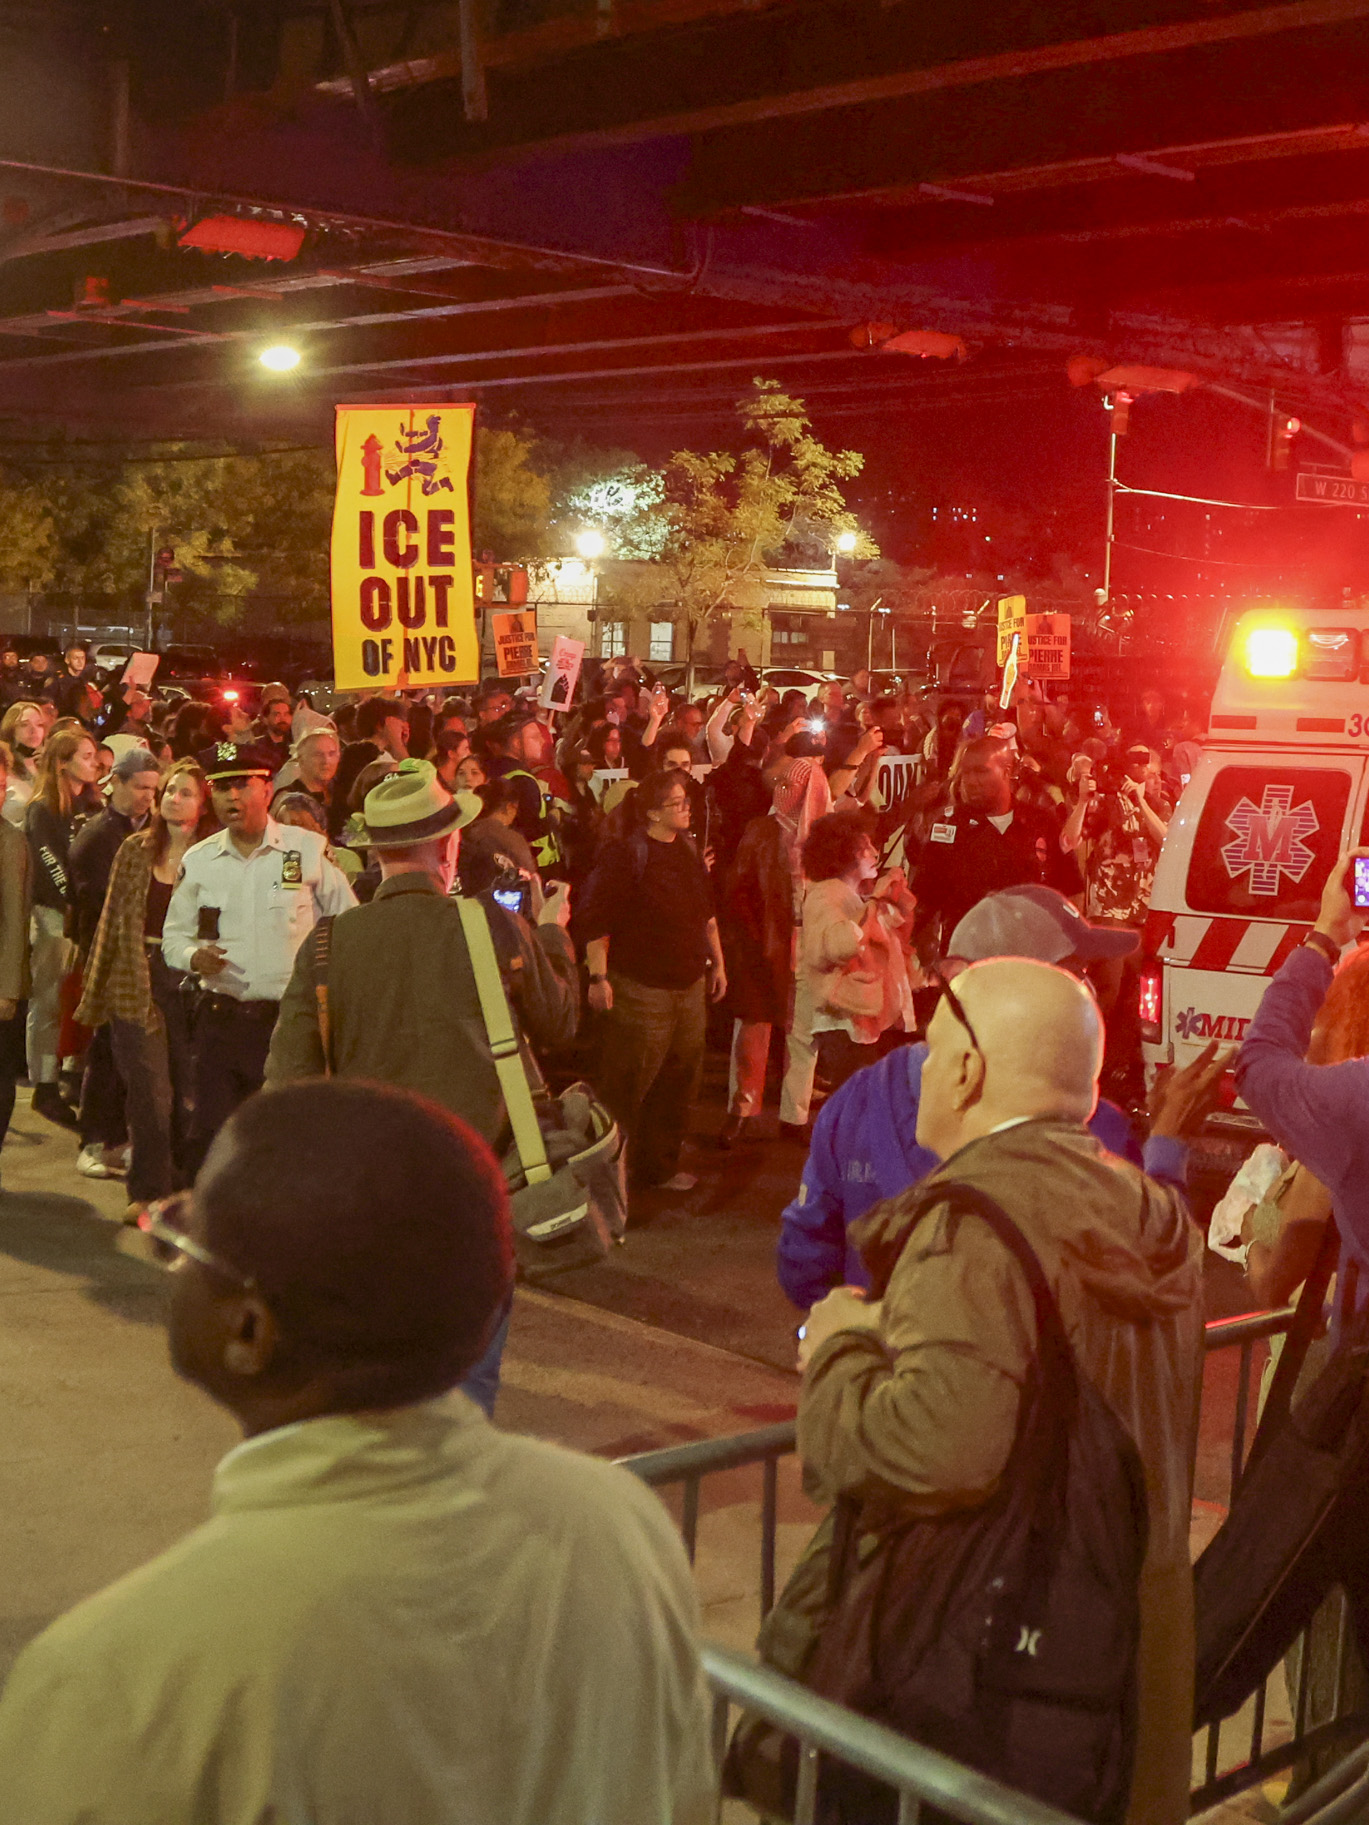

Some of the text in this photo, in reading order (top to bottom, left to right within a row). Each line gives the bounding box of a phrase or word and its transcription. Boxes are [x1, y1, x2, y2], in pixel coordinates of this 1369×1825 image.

[1314, 480, 1327, 496] W
[1332, 482, 1356, 500] 220
[358, 509, 456, 570] ICE
[359, 574, 454, 633] OUT
[1027, 635, 1052, 646] USTICE
[361, 635, 457, 677] OF NYC
[1028, 649, 1064, 663] PIERRE
[50, 864, 68, 887] THE
